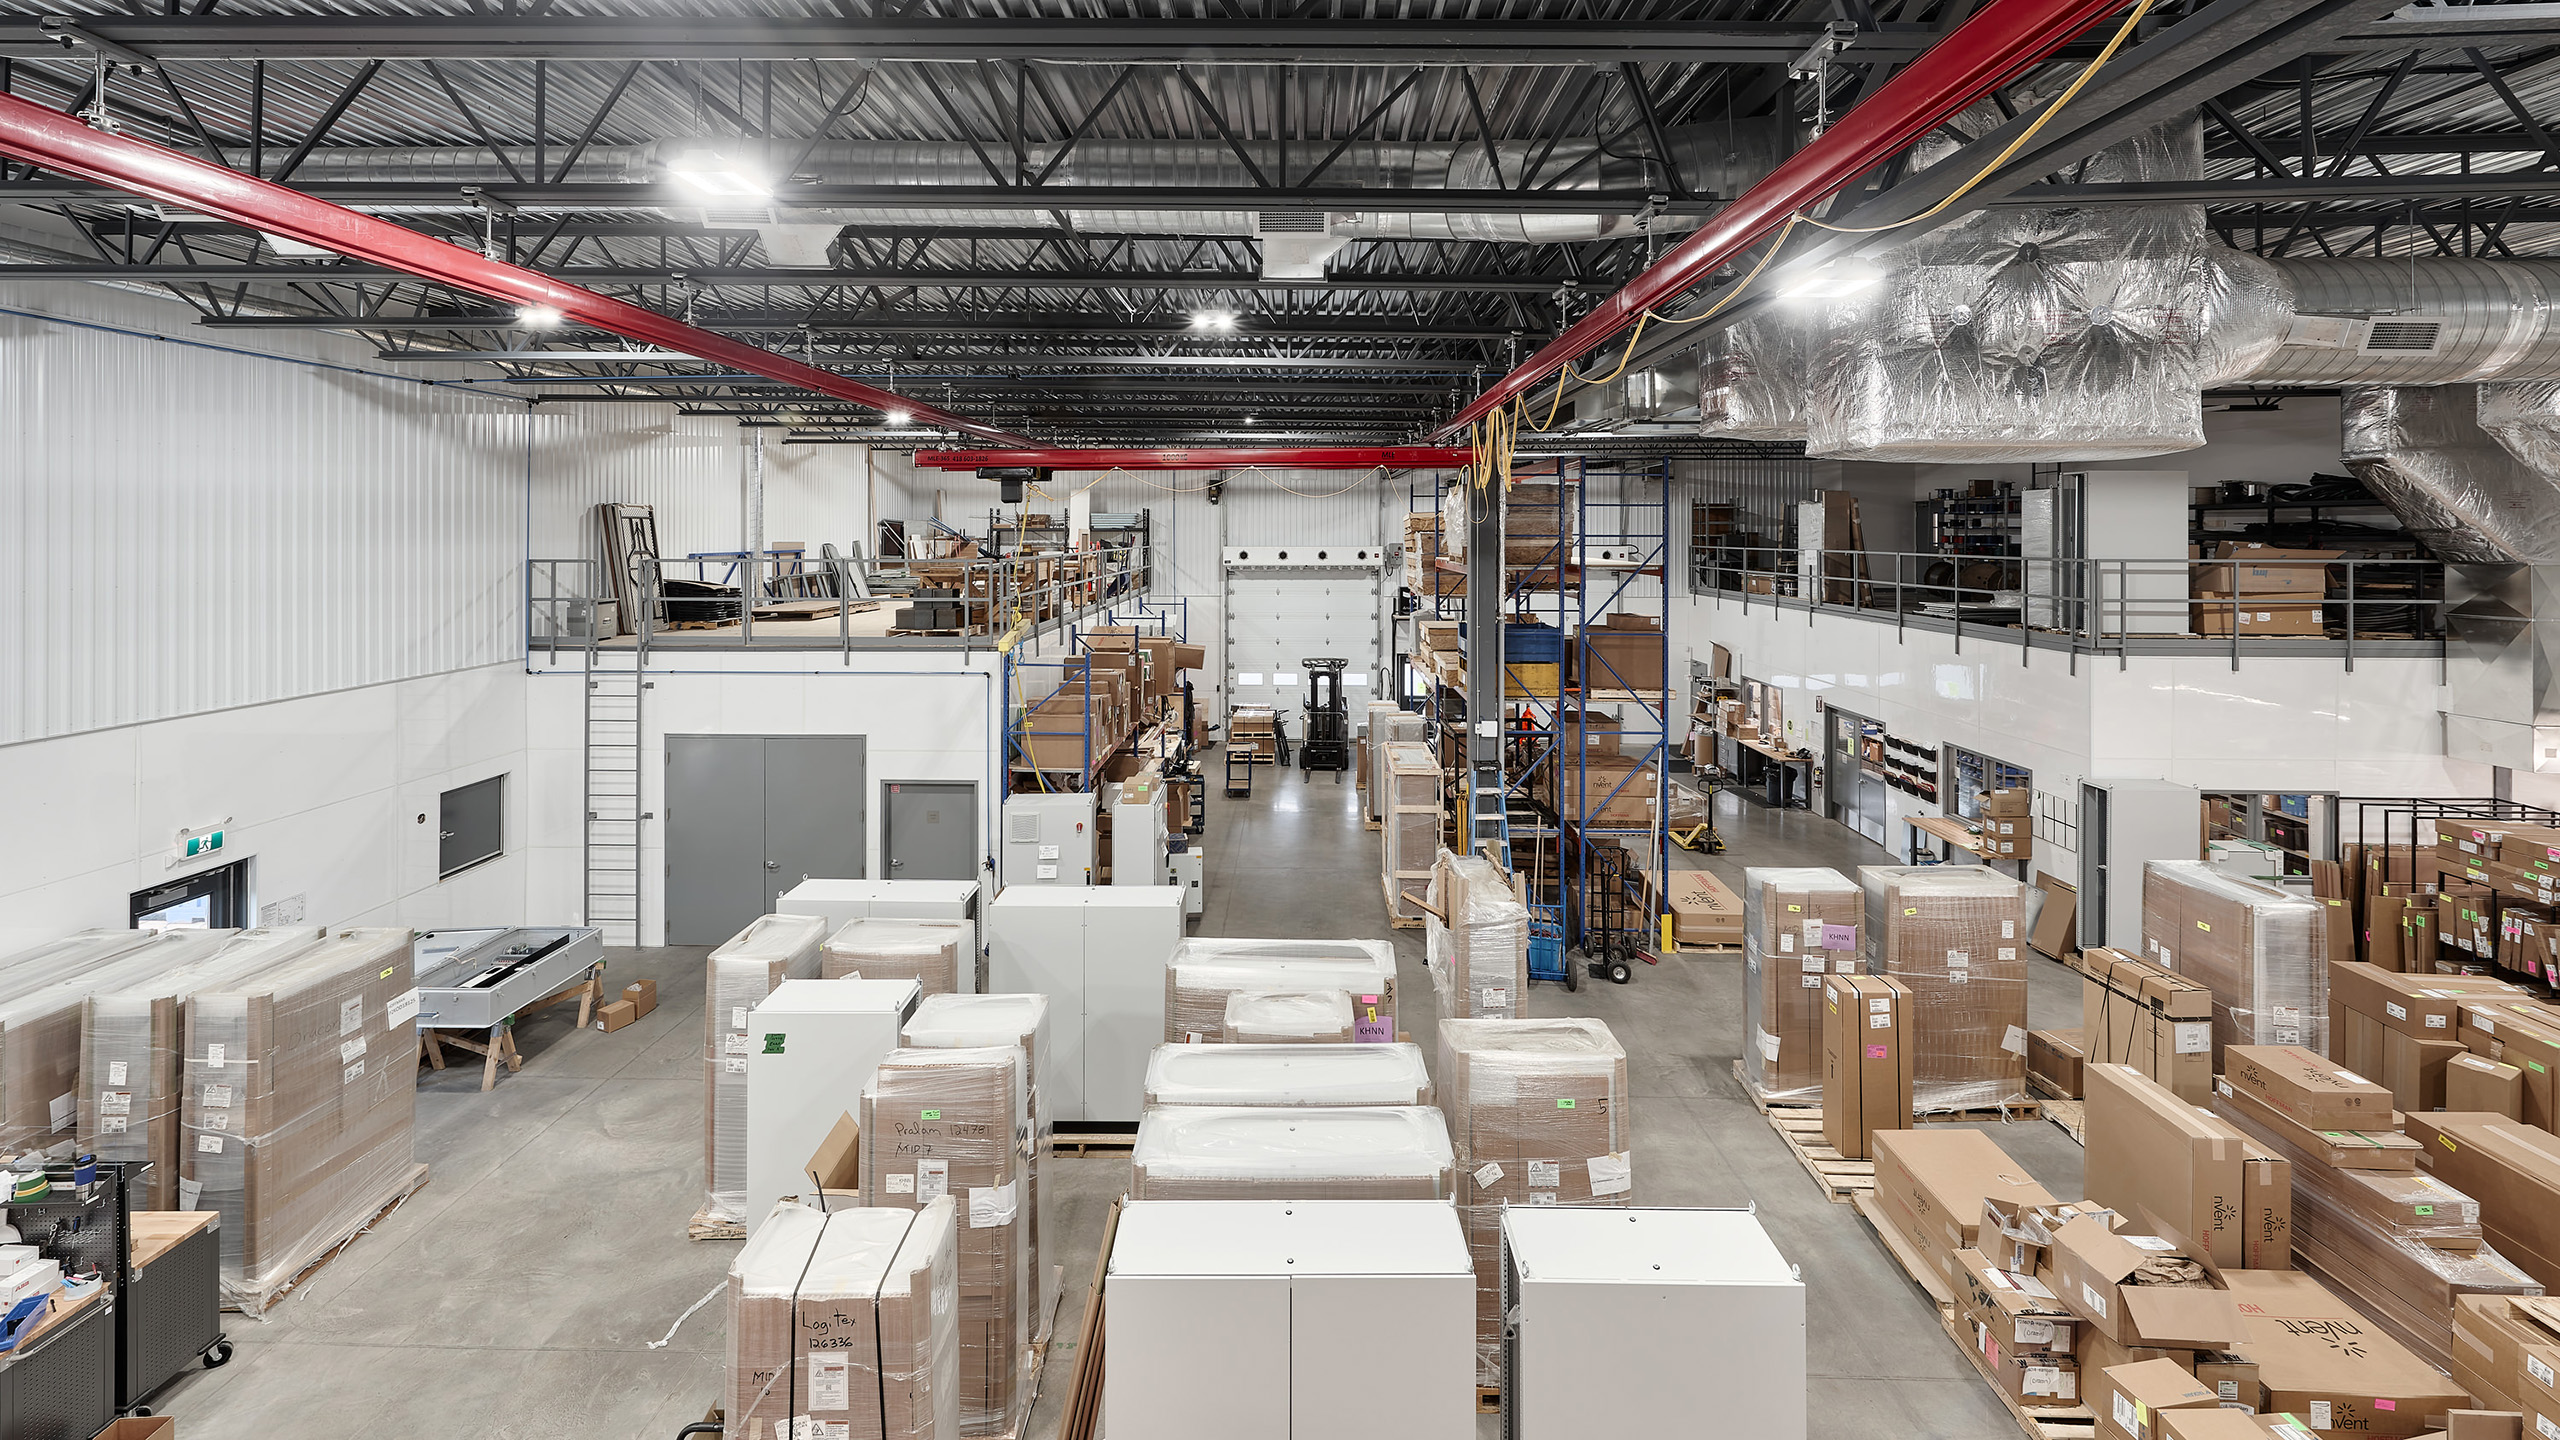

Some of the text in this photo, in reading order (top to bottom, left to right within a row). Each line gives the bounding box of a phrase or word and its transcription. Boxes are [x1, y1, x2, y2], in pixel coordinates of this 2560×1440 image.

[1828, 933, 1850, 941] KHNN
[1359, 1027, 1385, 1036] KHNN
[1598, 1098, 1608, 1115] 5
[2265, 1093, 2293, 1113] HOFFMAN
[809, 1336, 854, 1349] 126336
